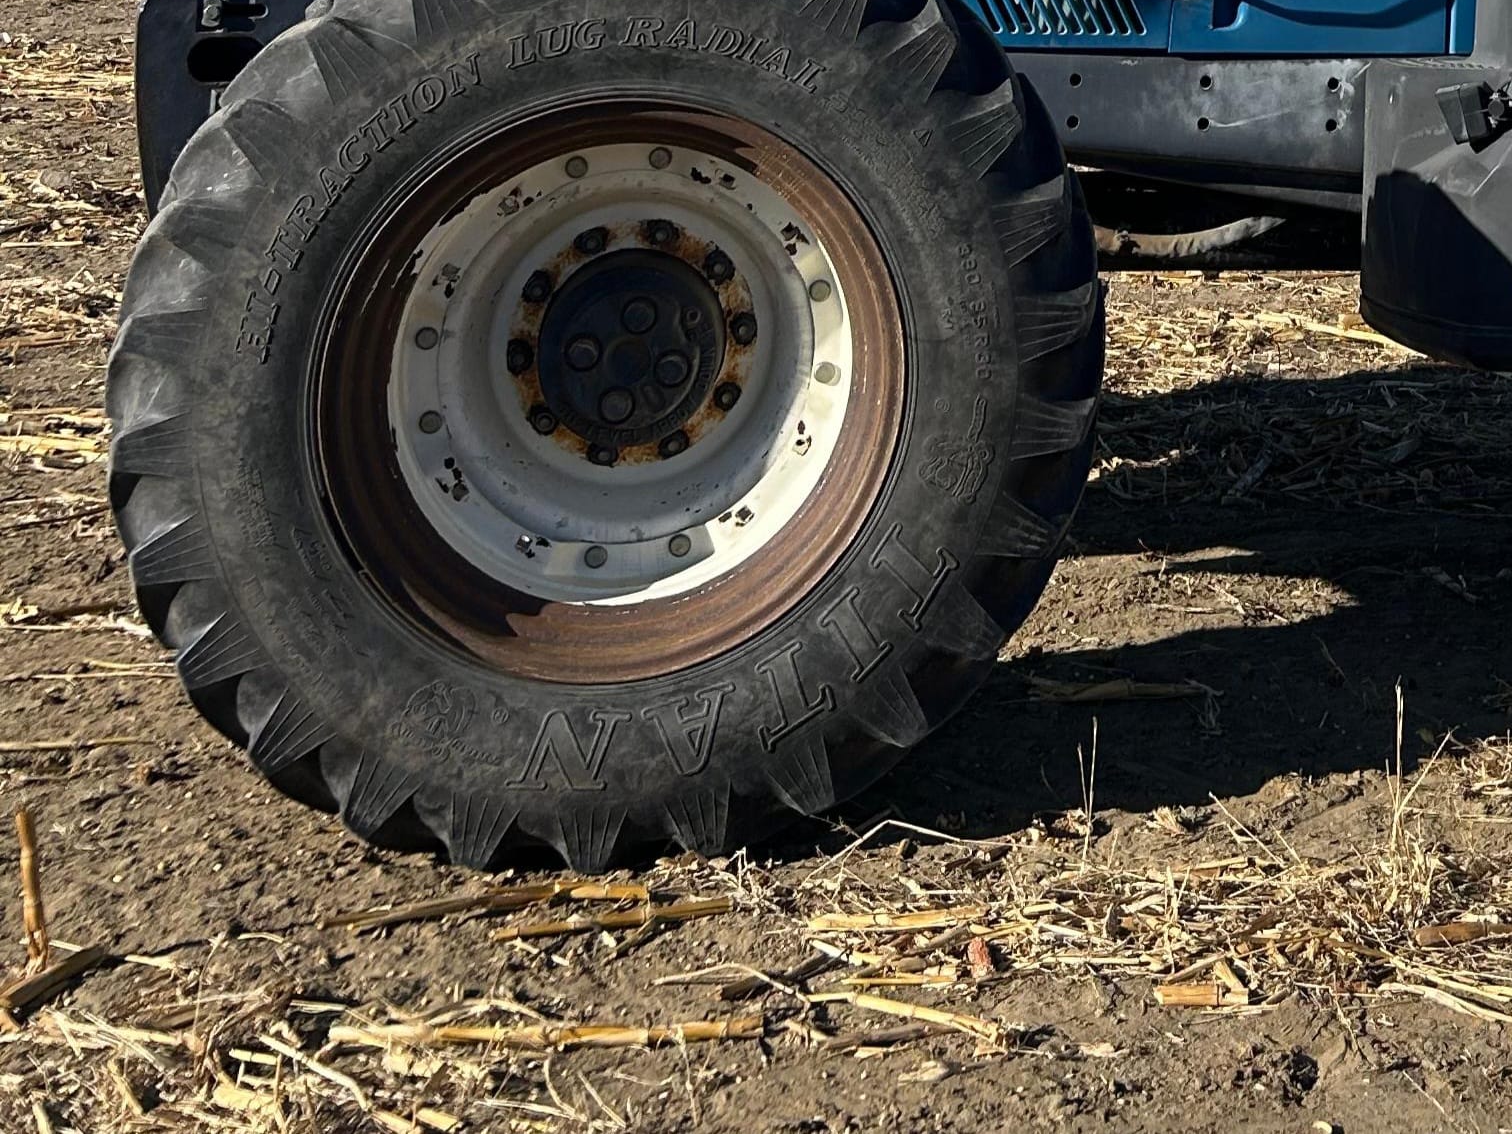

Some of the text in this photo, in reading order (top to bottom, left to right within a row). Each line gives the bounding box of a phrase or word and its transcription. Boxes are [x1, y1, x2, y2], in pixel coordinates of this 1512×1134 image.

[235, 16, 832, 365] HI-TRACTION LUG RADIAL
[503, 522, 960, 792] TITAN
